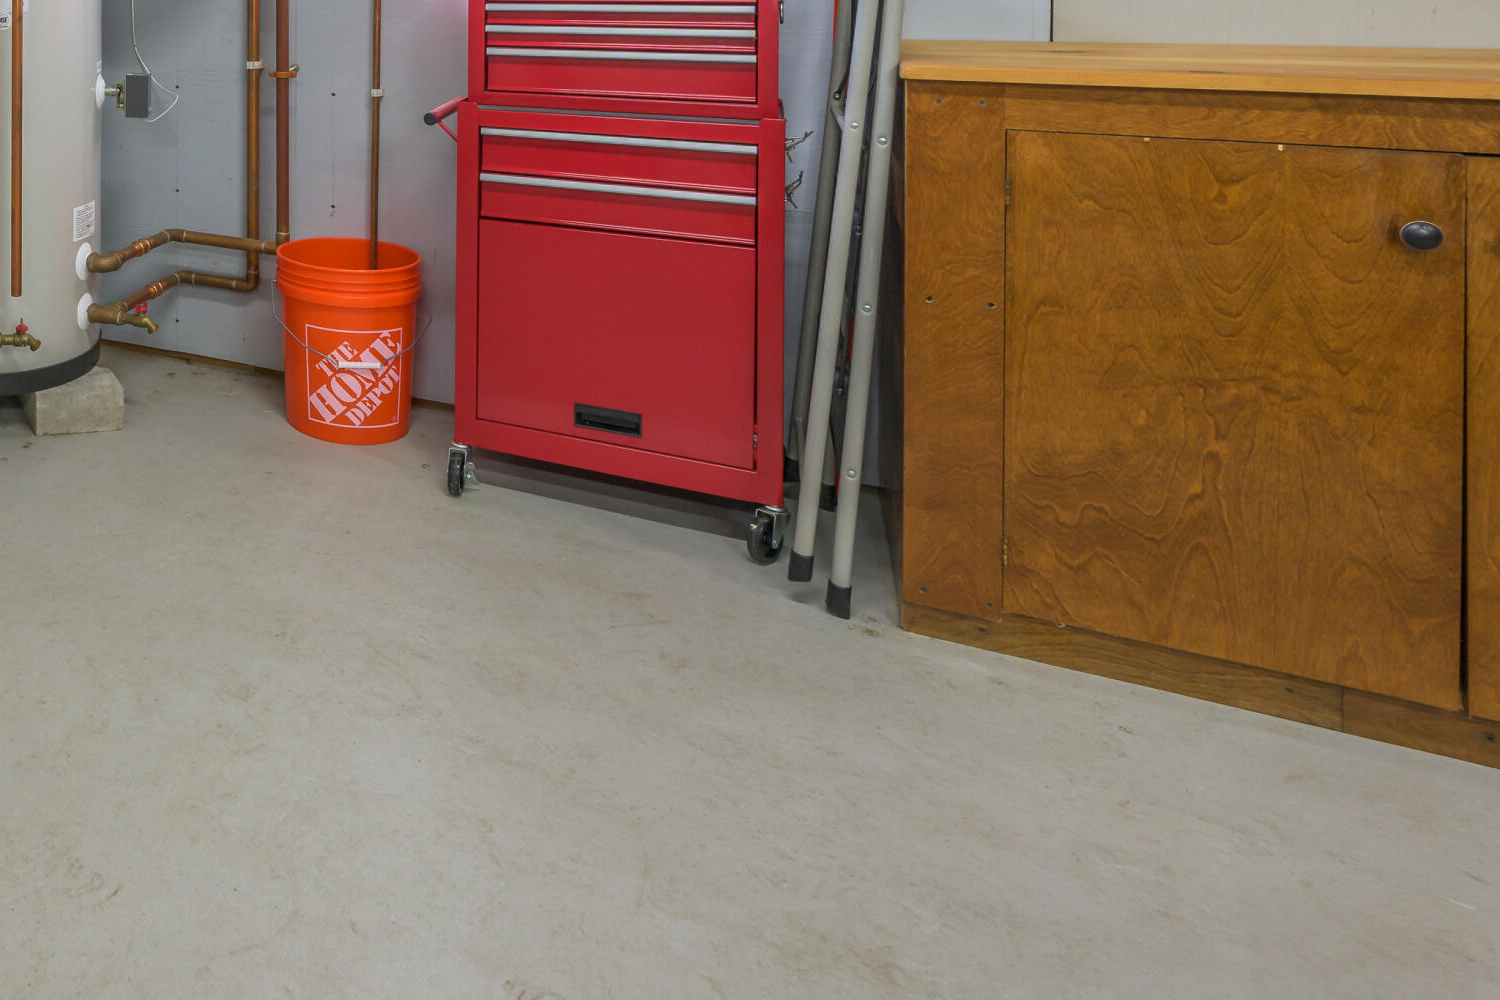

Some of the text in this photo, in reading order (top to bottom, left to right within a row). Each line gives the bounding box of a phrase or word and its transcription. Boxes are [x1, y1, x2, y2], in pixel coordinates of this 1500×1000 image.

[309, 331, 401, 423] HOME
[315, 341, 358, 376] THE
[345, 365, 400, 427] DEPOT
